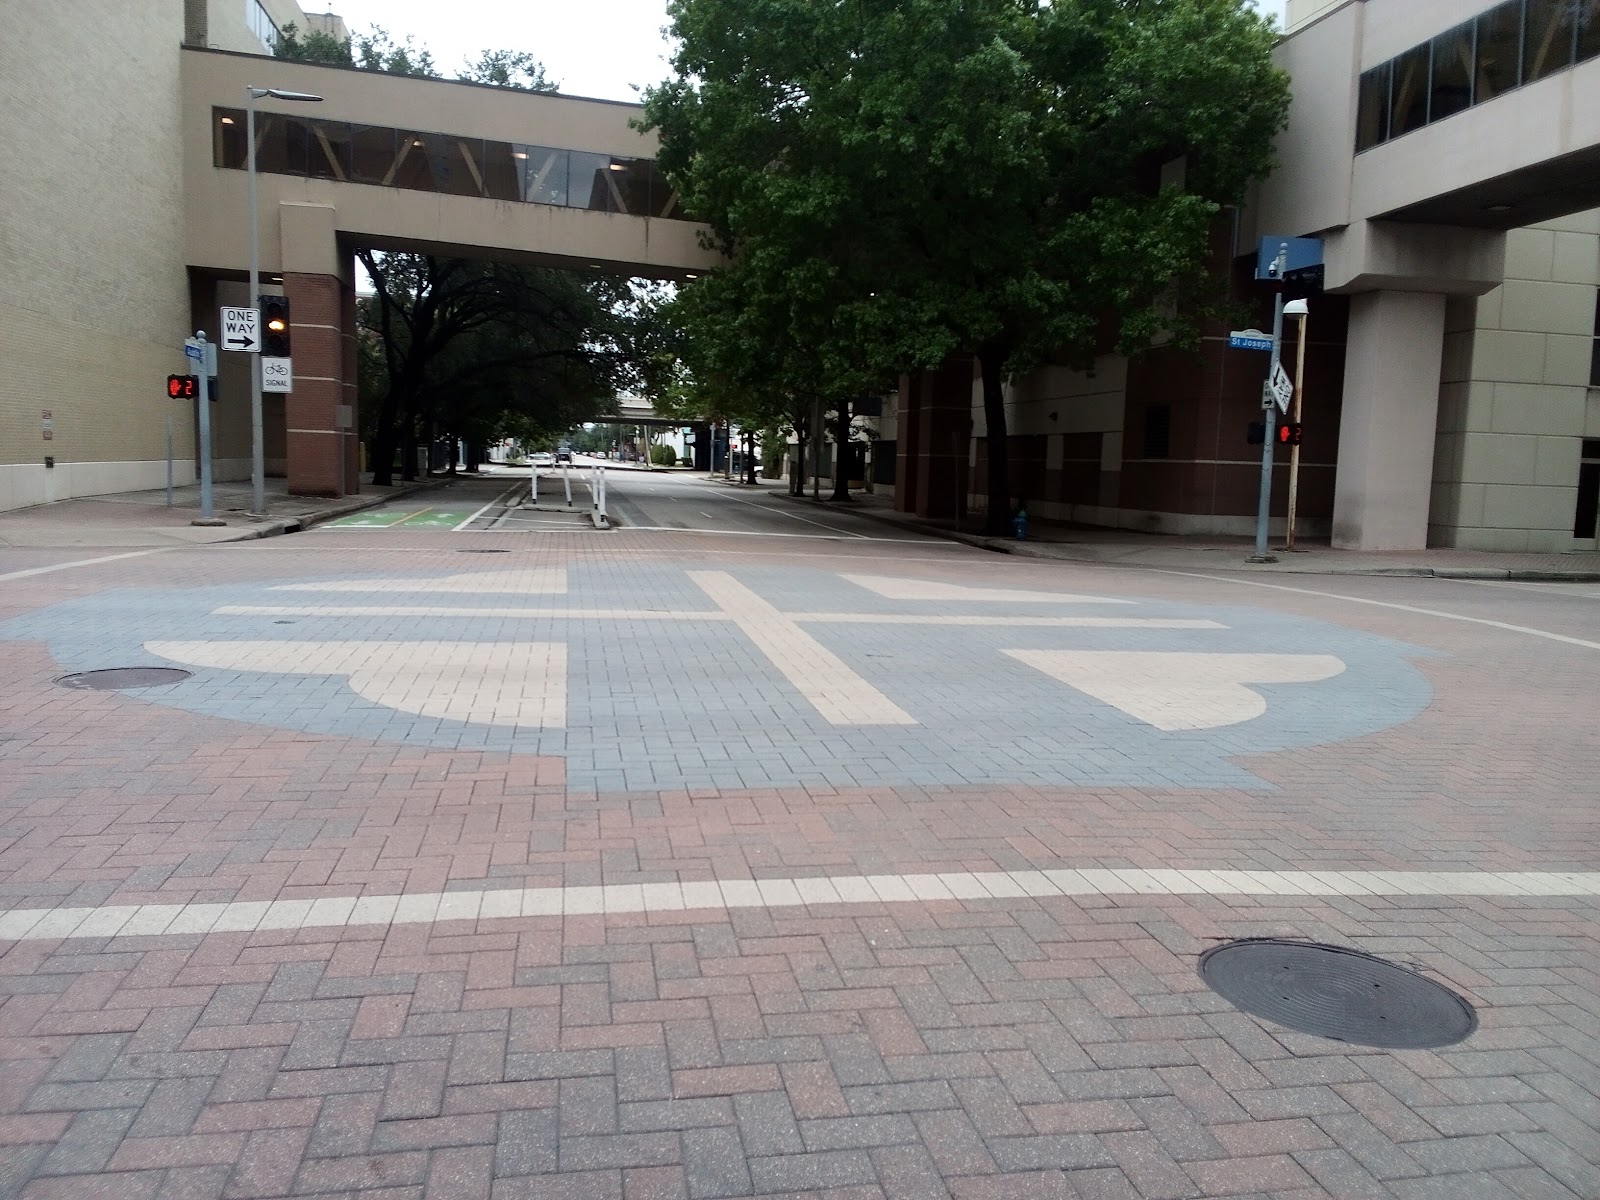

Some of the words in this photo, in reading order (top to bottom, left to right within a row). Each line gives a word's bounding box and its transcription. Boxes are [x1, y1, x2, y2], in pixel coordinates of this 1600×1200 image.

[228, 311, 254, 322] ONE
[226, 323, 255, 334] WAY
[1231, 337, 1241, 346] St
[1242, 339, 1271, 349] Joseph
[185, 380, 193, 395] 2
[265, 379, 288, 388] SIGNAL
